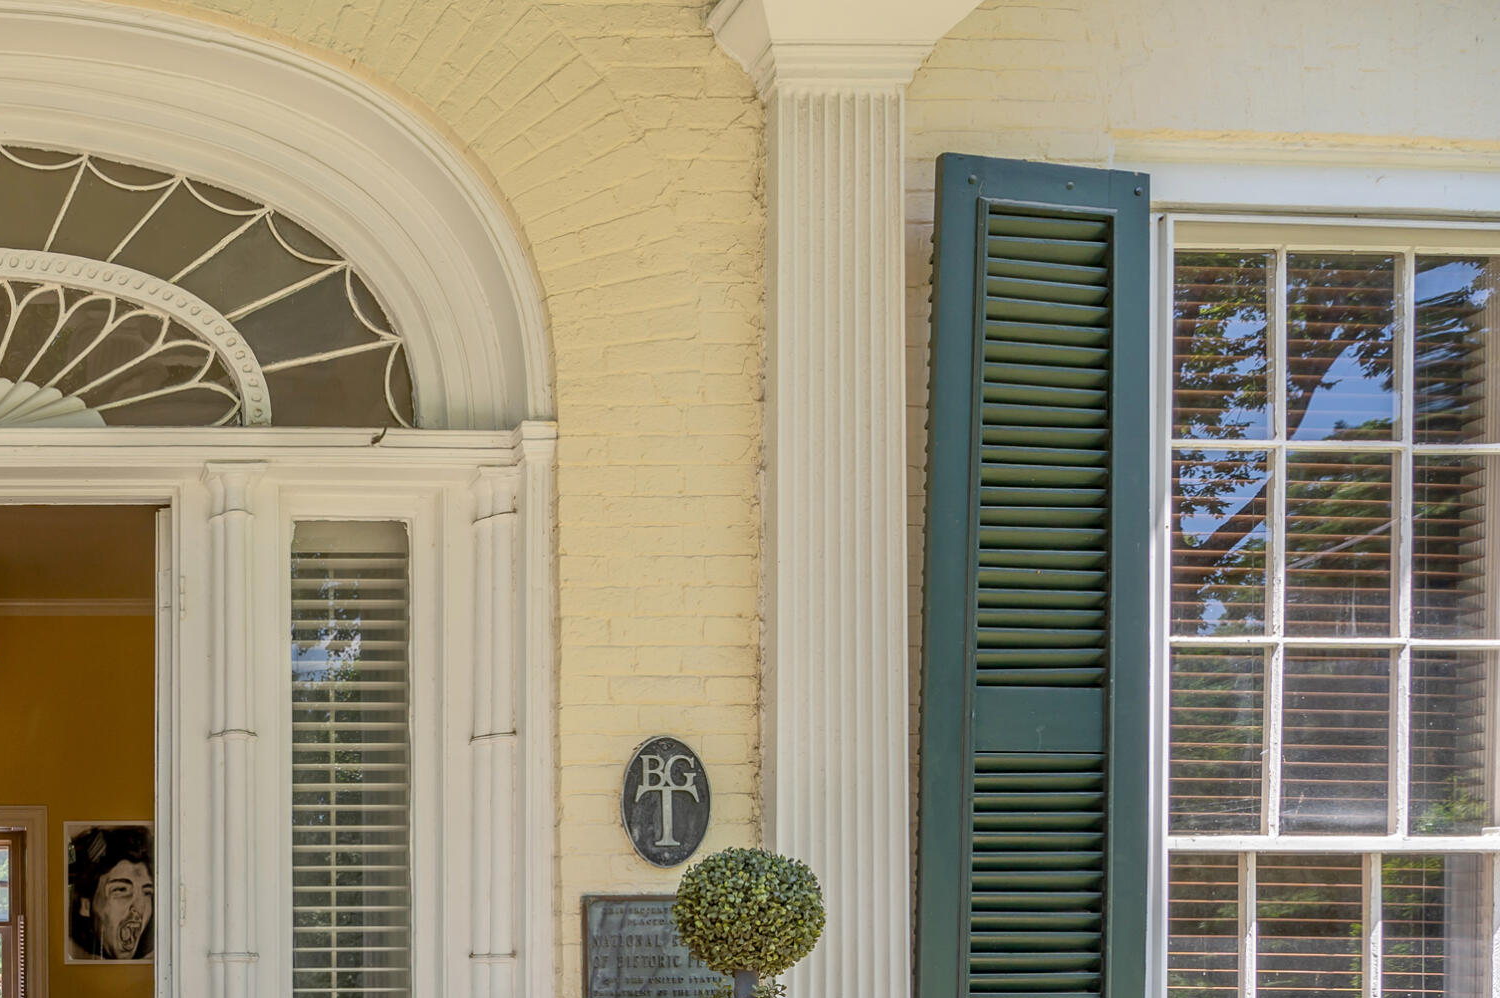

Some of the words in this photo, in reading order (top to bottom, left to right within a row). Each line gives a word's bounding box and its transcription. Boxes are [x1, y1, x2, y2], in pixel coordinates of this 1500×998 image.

[592, 935, 662, 947] NATIONAL
[593, 956, 608, 968] OF
[617, 956, 680, 968] HISTORIC
